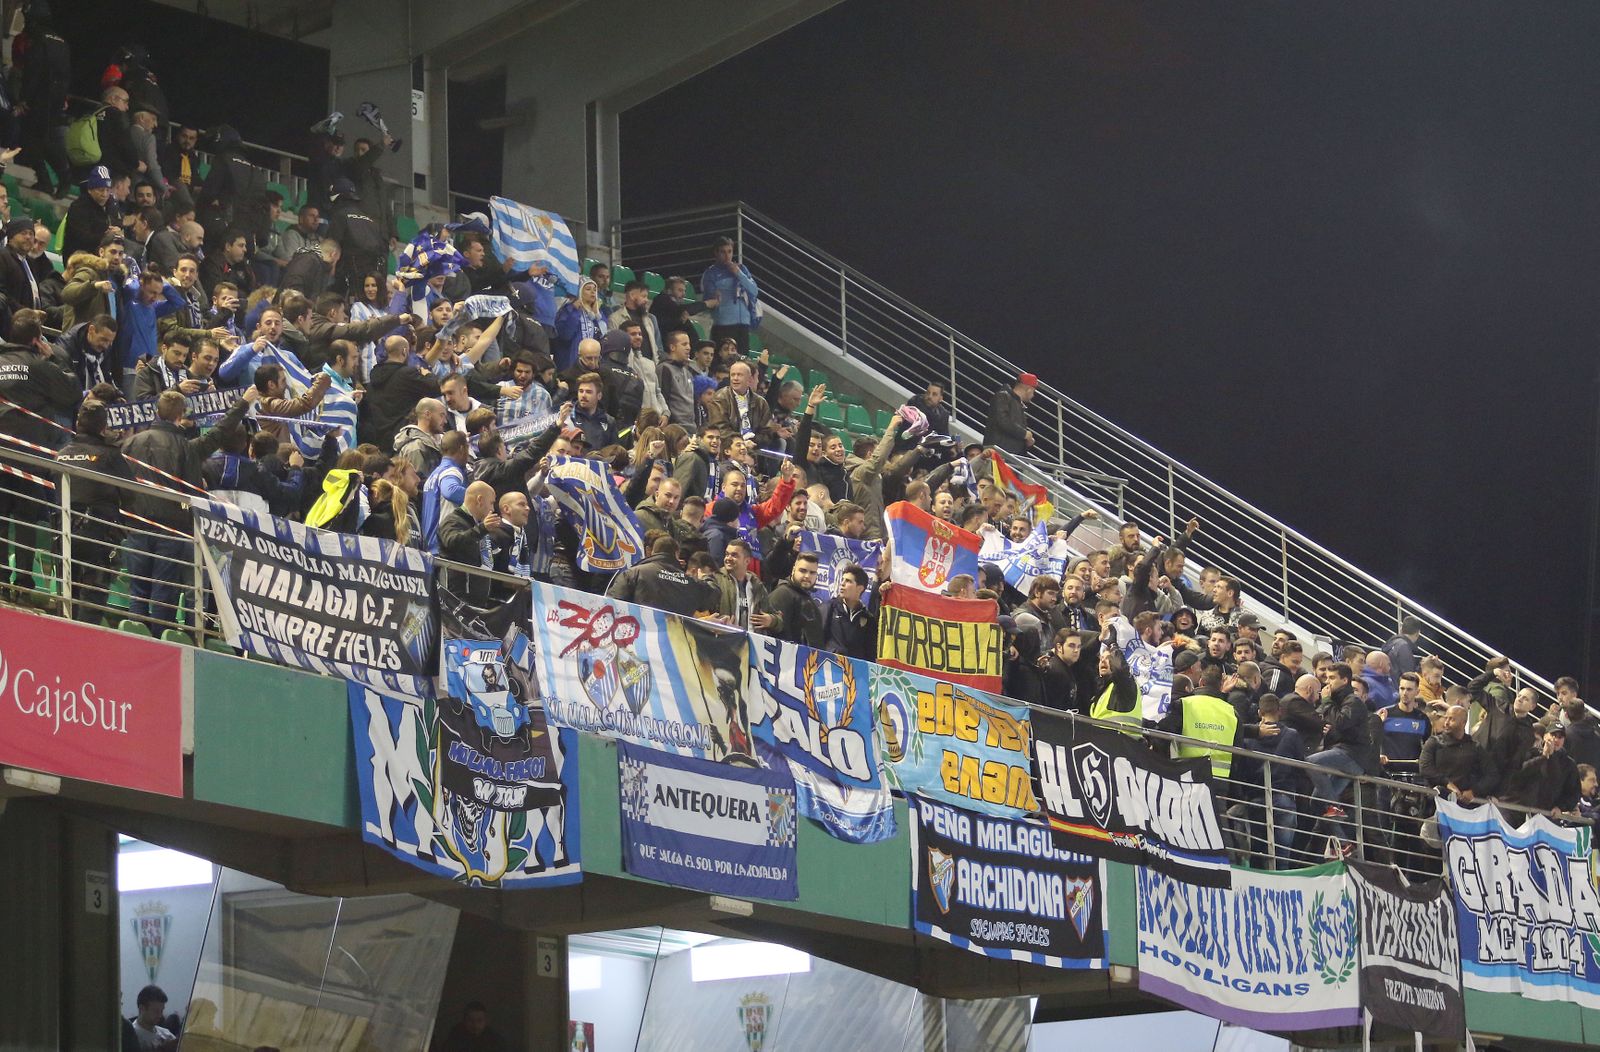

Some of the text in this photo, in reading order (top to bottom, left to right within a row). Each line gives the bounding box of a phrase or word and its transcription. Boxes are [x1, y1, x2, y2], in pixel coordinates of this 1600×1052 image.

[199, 515, 253, 550] PEÑA
[256, 536, 334, 578] ORGULLO
[240, 559, 398, 630] MALAGA C.F.
[236, 597, 402, 671] SIEMPRE FIELES
[879, 606, 1001, 676] MARBELLA
[748, 631, 806, 702] EL
[13, 668, 133, 736] CajaSur
[750, 667, 873, 783] PALO
[1194, 722, 1225, 732] SEGURIDAD
[653, 783, 761, 823] ANTEQUERA
[918, 800, 972, 845] PEÑA
[695, 856, 713, 872] SOL
[957, 859, 1065, 919] ARCHIDONA
[1446, 833, 1600, 934] GRADA
[93, 888, 102, 909] 3
[544, 954, 552, 973] 3
[1139, 940, 1311, 997] HOOLIGANS
[1529, 925, 1586, 978] 1904
